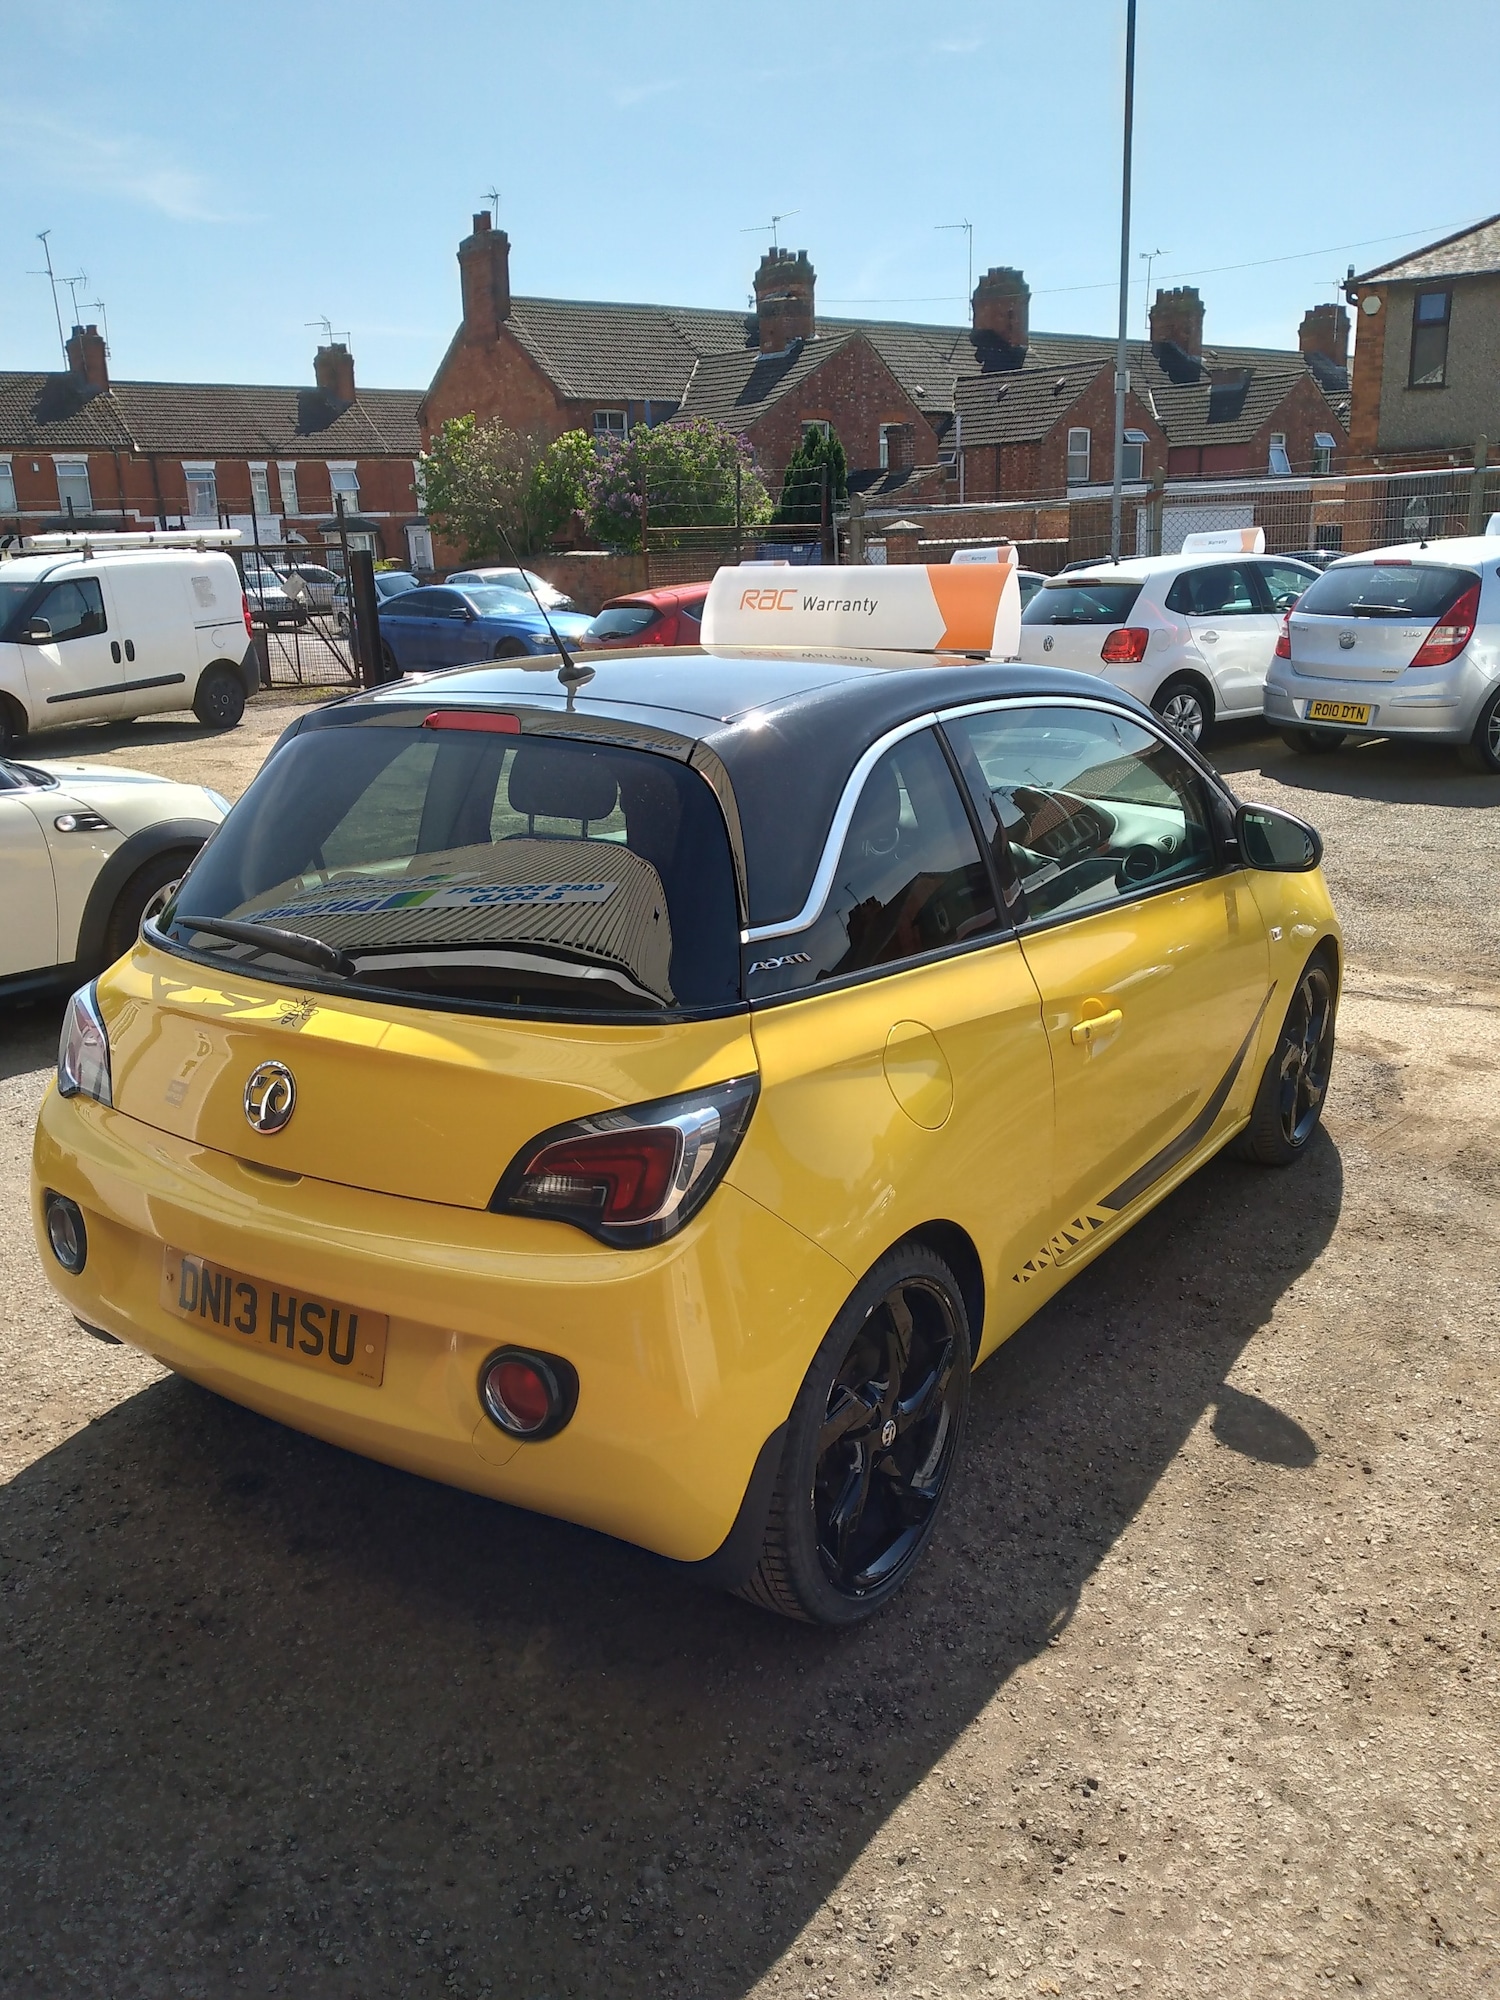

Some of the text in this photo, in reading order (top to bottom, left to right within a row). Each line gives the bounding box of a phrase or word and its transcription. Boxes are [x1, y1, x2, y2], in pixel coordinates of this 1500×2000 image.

[802, 596, 878, 616] Warranty
[1314, 702, 1366, 720] RO10 DTN
[179, 1259, 358, 1366] DN13 HSU
